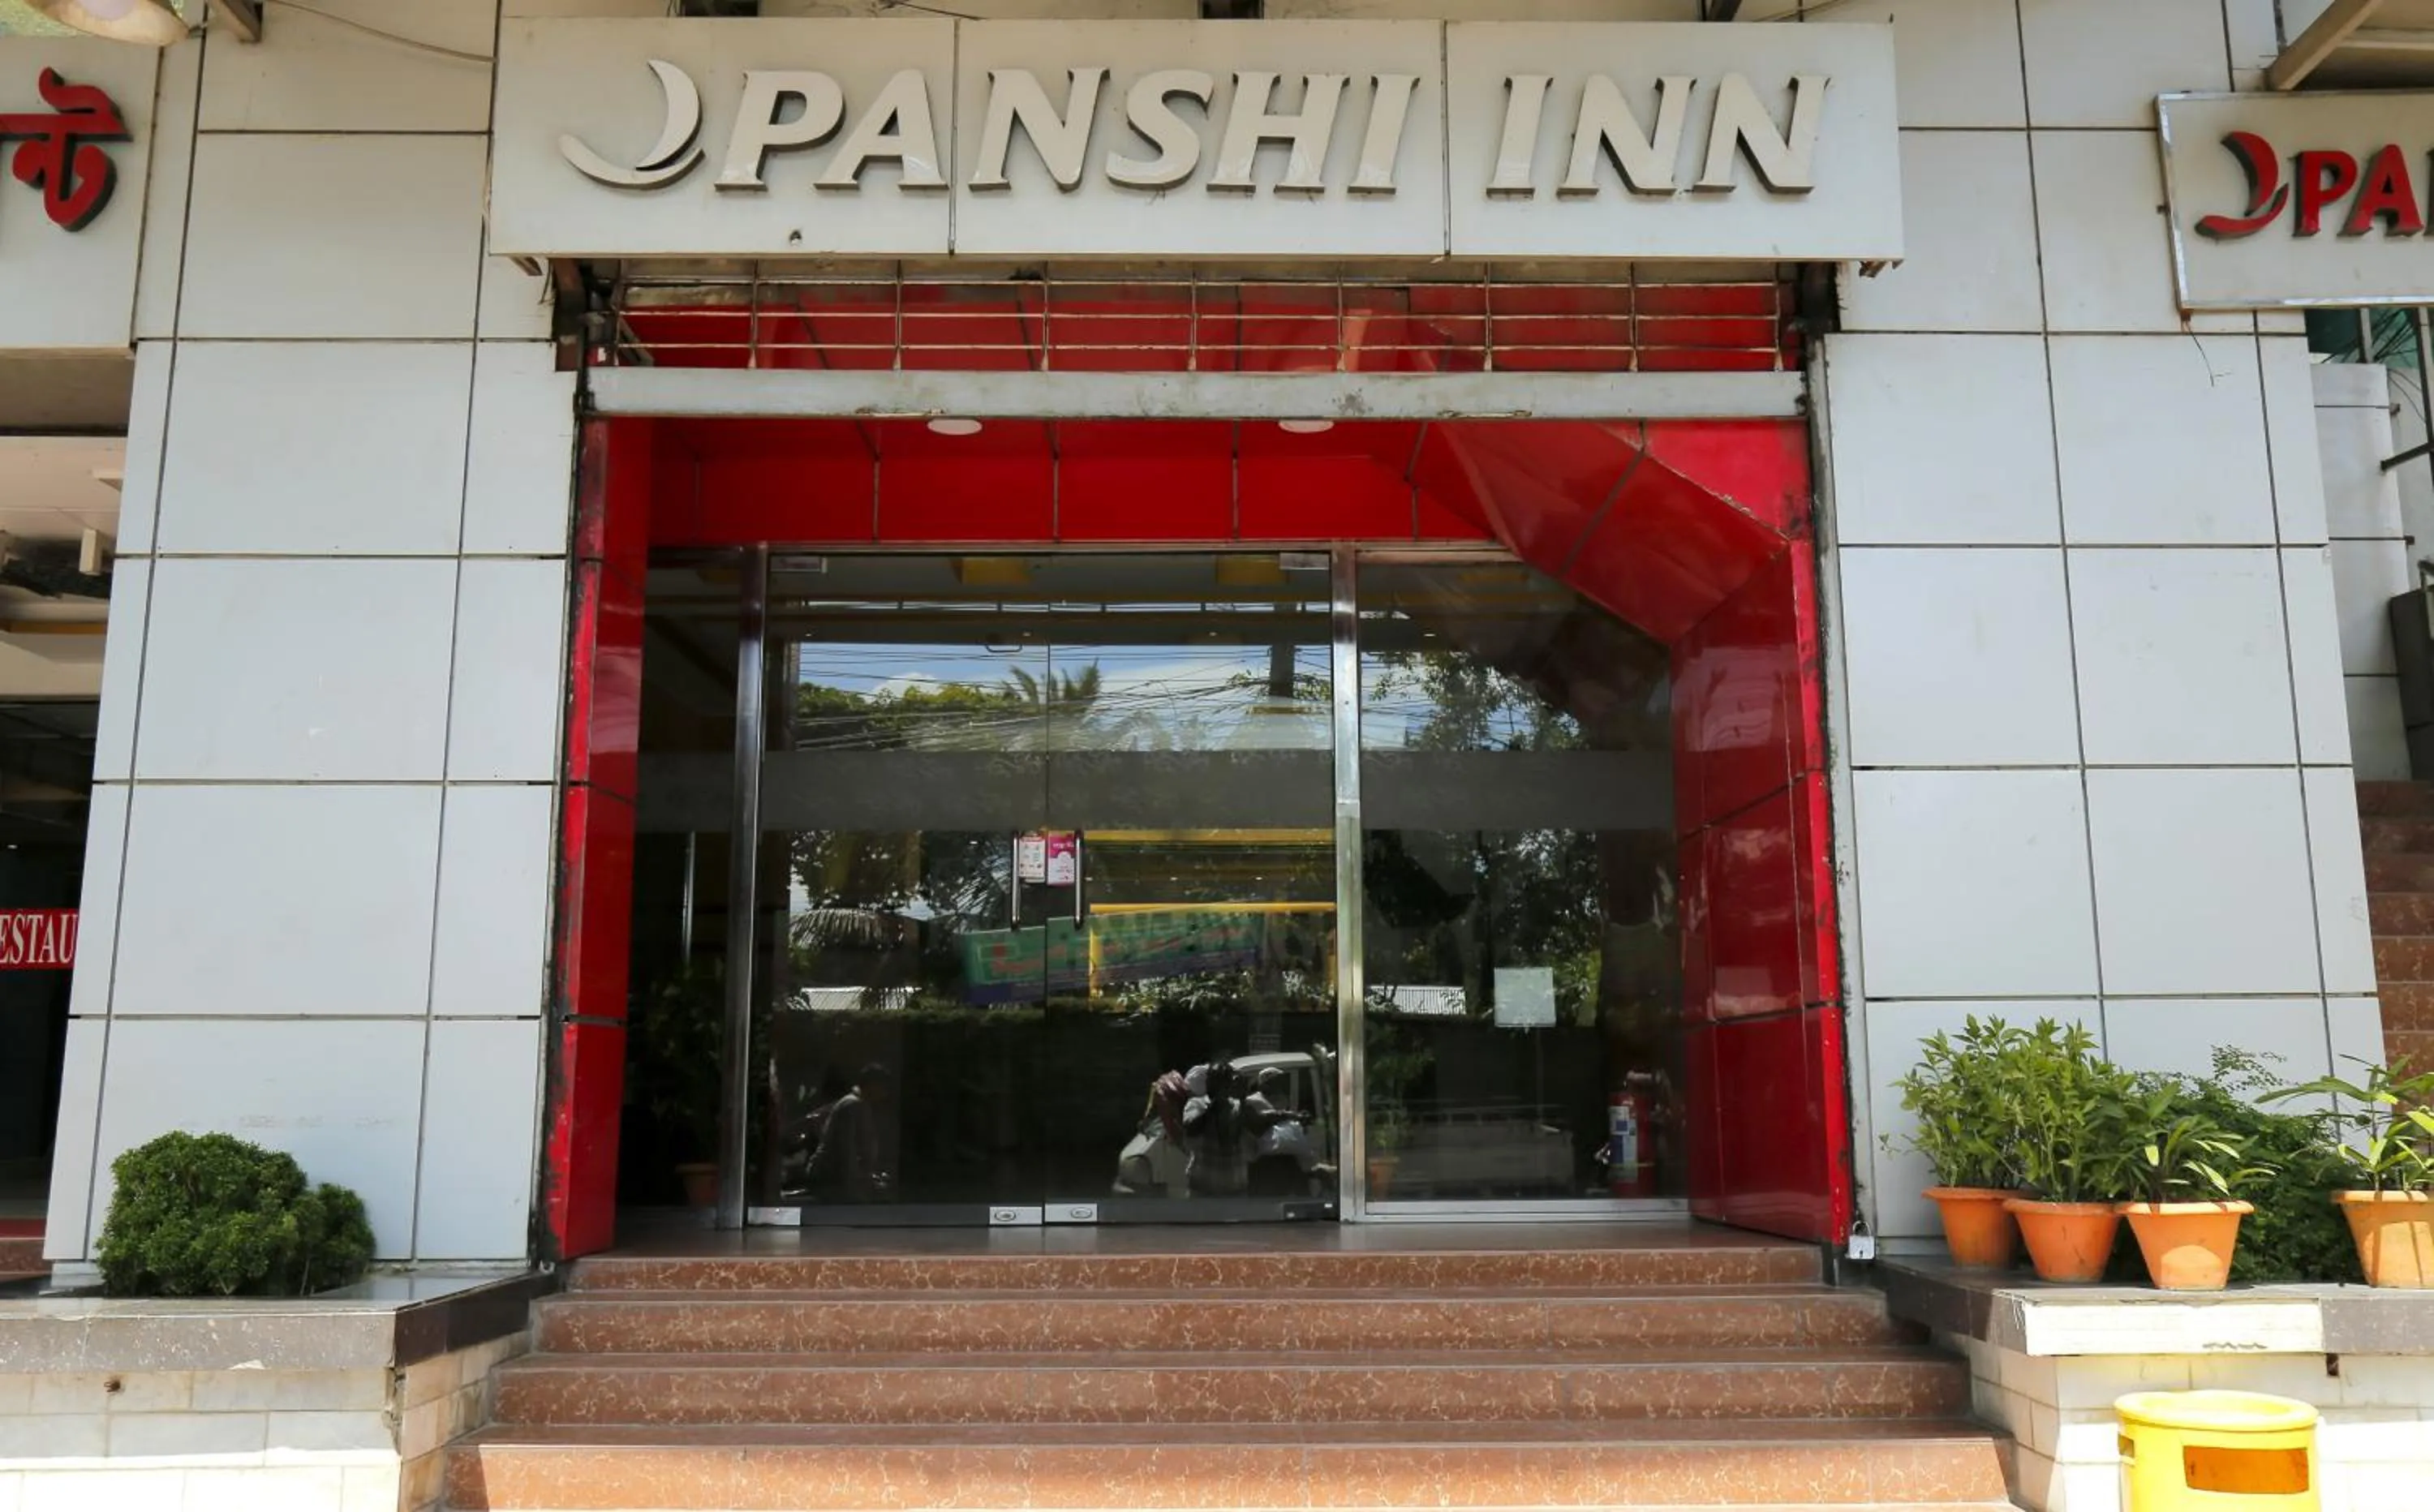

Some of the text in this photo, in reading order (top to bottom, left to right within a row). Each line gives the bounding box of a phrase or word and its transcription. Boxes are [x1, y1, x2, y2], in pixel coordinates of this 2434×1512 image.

[714, 67, 1831, 198] PANSHI INN
[2287, 144, 2434, 237] PA
